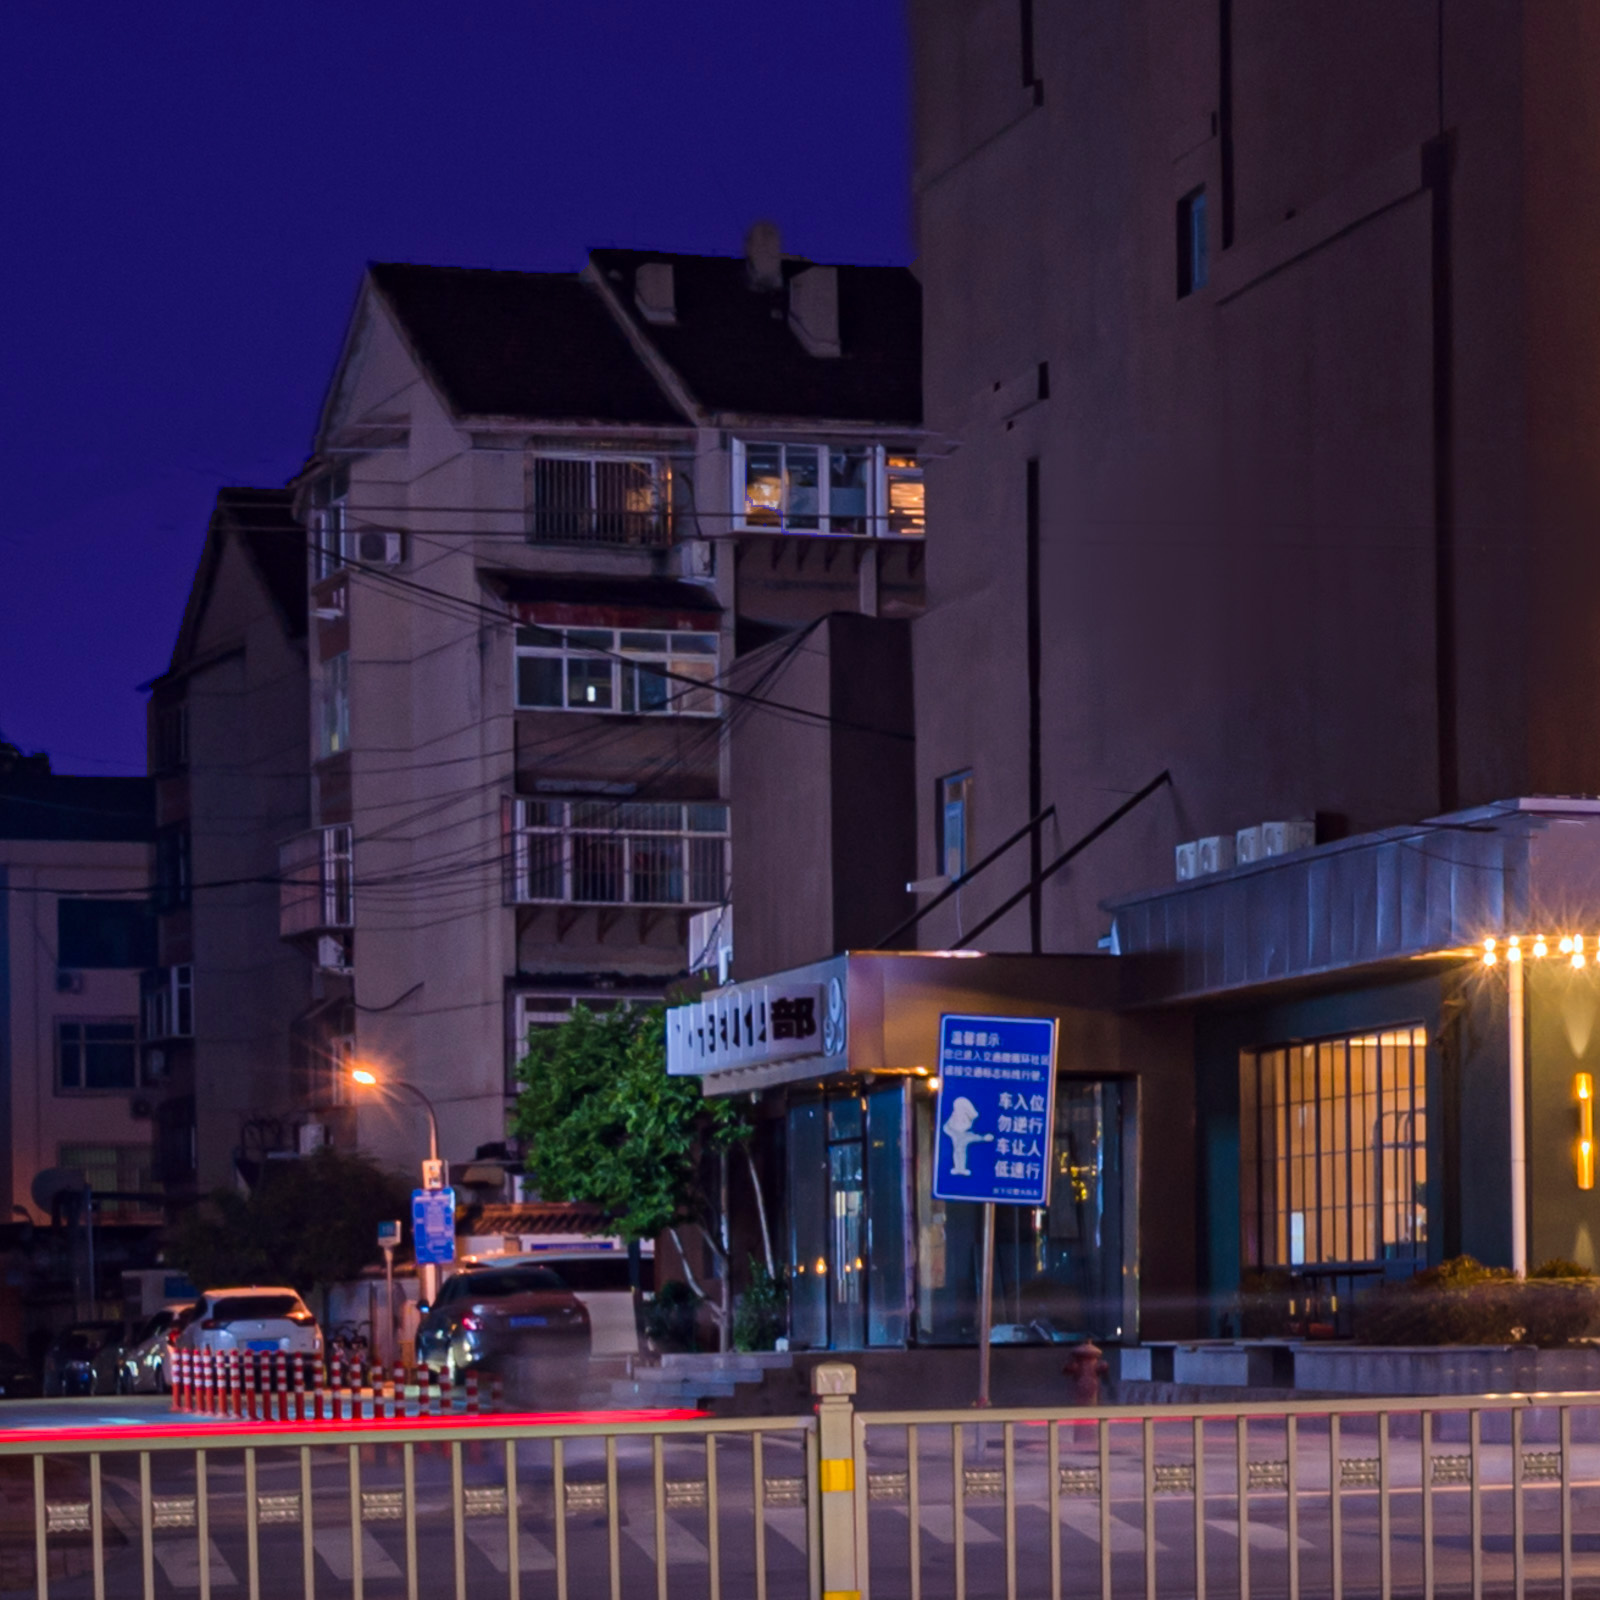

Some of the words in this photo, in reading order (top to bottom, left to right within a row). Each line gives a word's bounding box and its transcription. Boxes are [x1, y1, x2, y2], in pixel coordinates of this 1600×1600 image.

[998, 1091, 1045, 1112] 车入位
[997, 1114, 1043, 1135] 勿逆行
[995, 1137, 1042, 1157] 车让人
[994, 1160, 1041, 1180] 低速行
